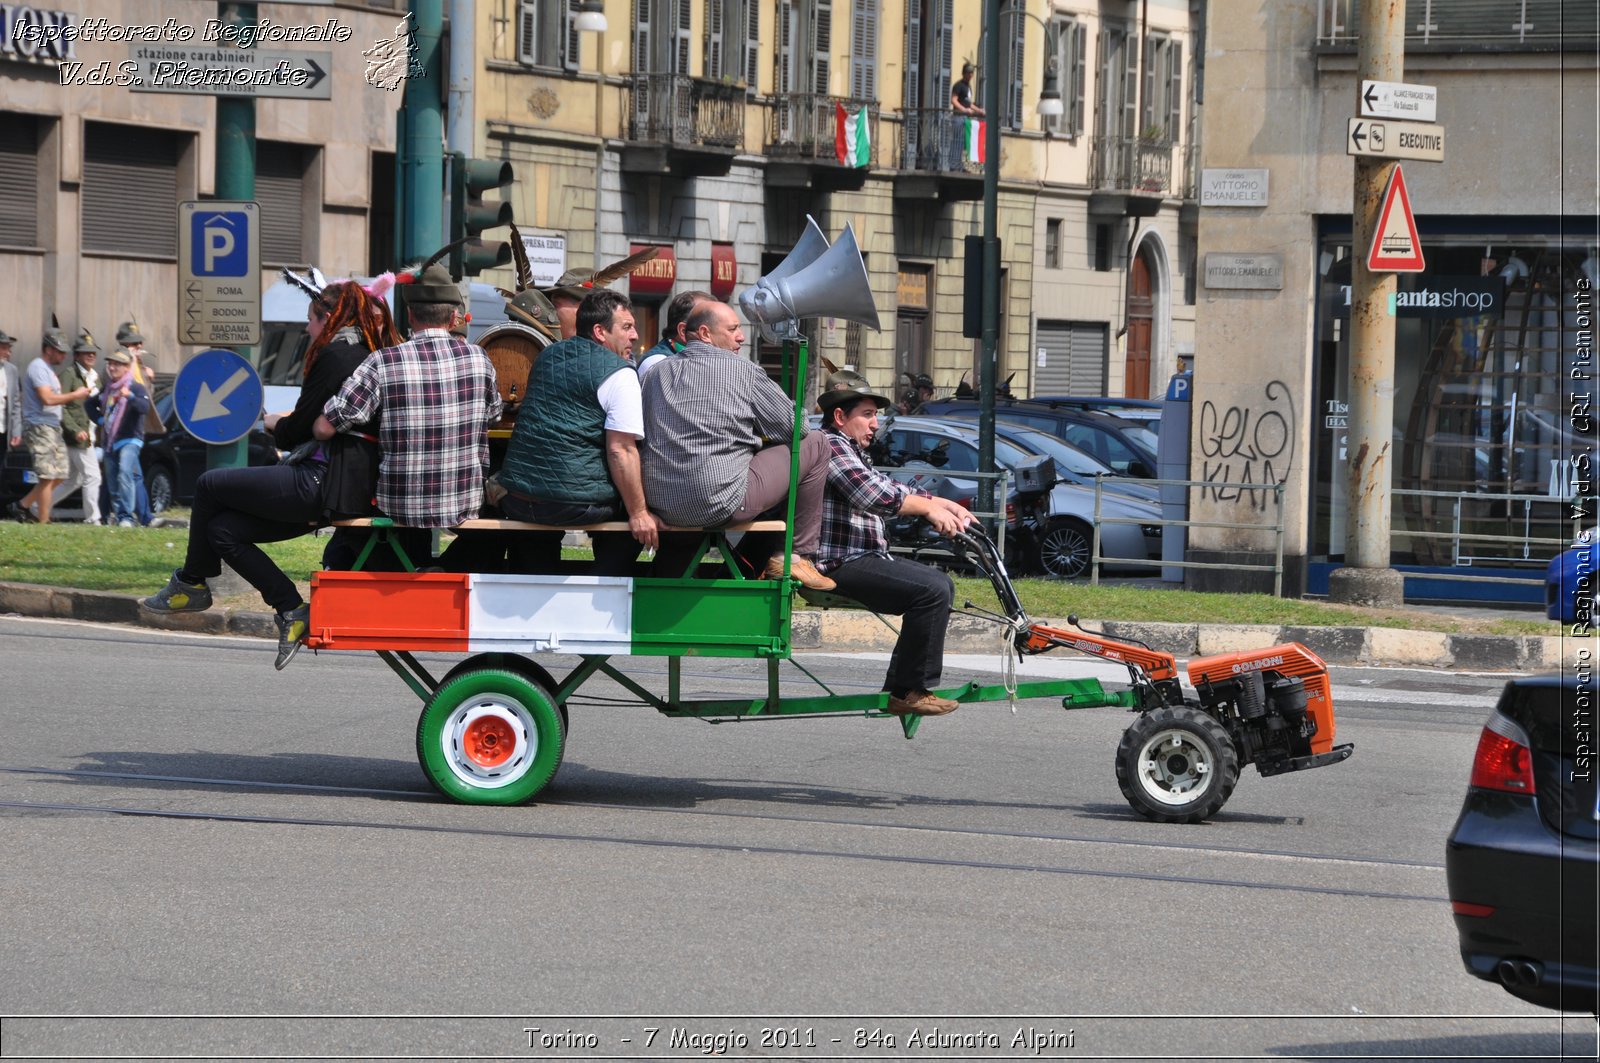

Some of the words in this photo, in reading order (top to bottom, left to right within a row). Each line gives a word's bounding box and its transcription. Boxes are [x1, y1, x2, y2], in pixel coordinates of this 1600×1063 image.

[137, 47, 187, 61] stazione
[191, 51, 255, 63] carabinieri
[1399, 132, 1442, 151] EXECUTIVE
[1212, 181, 1259, 190] VITTORIO
[1204, 191, 1257, 201] EMANUELE
[523, 238, 546, 248] PRESA
[204, 226, 235, 272] P
[1207, 267, 1237, 276] VITTORIO
[1239, 267, 1272, 277] EMANUELE
[216, 286, 243, 296] ROMA
[212, 308, 247, 317] BODONI
[211, 324, 250, 333] MADAMA
[209, 332, 250, 341] CRISTINA
[1175, 379, 1187, 398] P
[1232, 656, 1284, 673] GOLDONI
